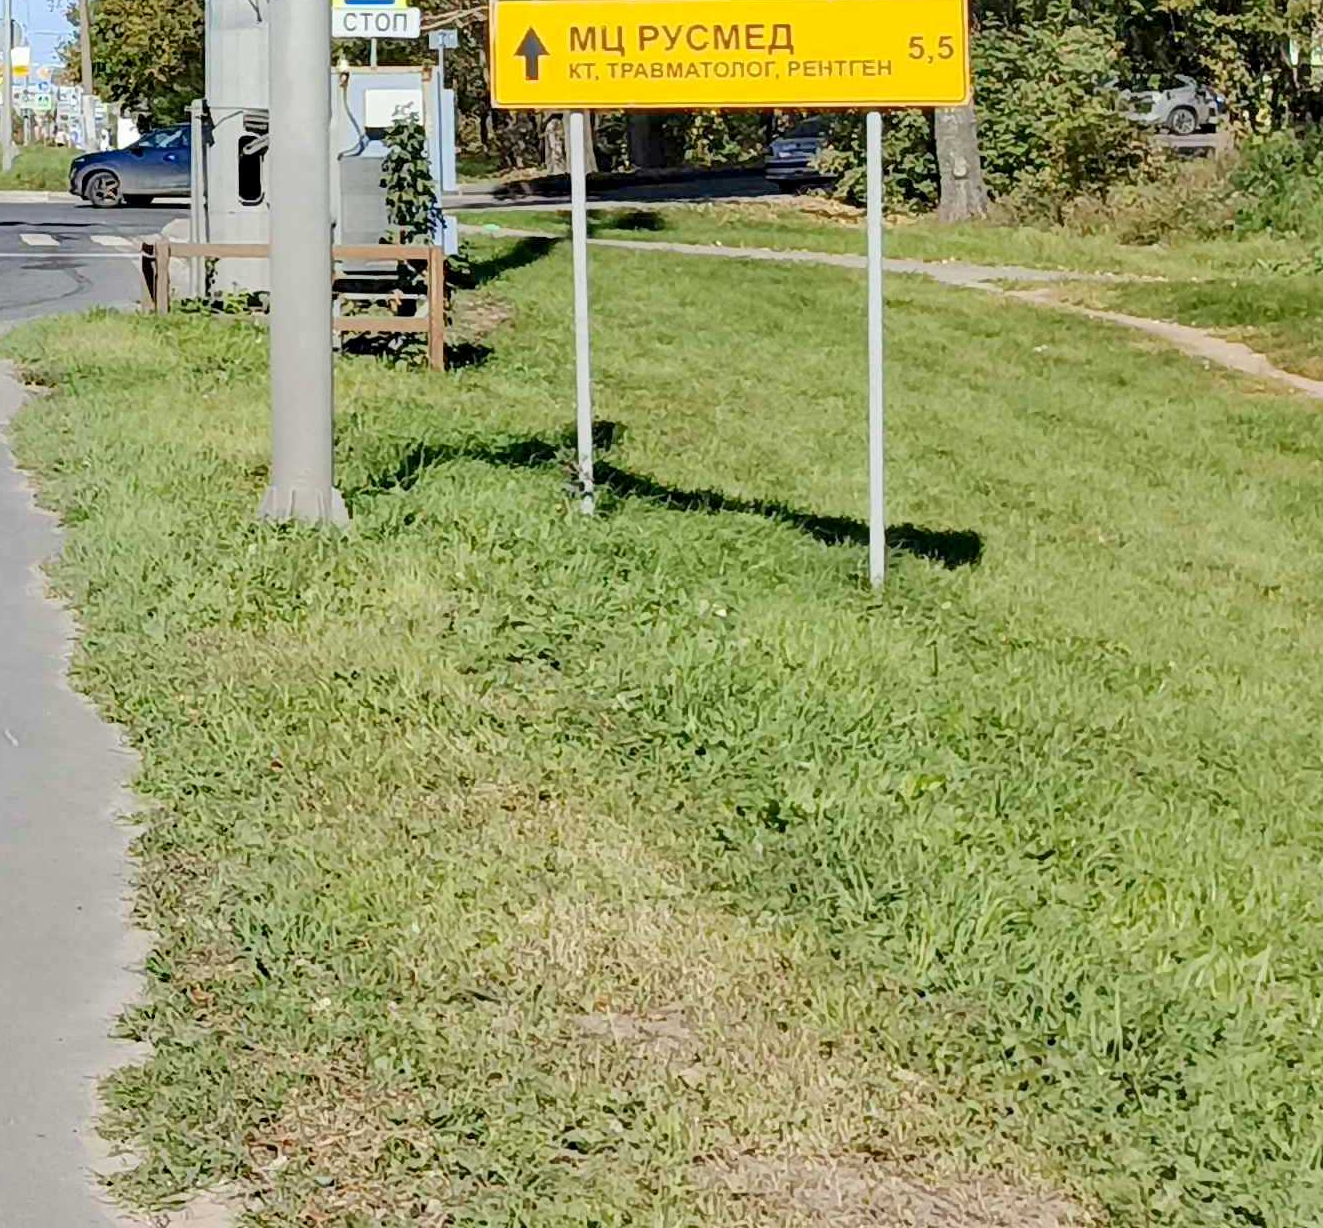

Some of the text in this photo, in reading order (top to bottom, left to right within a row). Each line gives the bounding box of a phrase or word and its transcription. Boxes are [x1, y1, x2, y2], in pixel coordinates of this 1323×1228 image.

[343, 13, 408, 32] СТОП
[569, 23, 795, 57] МЦ РУСМЕД
[908, 35, 955, 65] 5,5
[569, 58, 892, 82] КТ, ТРАВМАТОЛОГ, РЕНТГЕН
